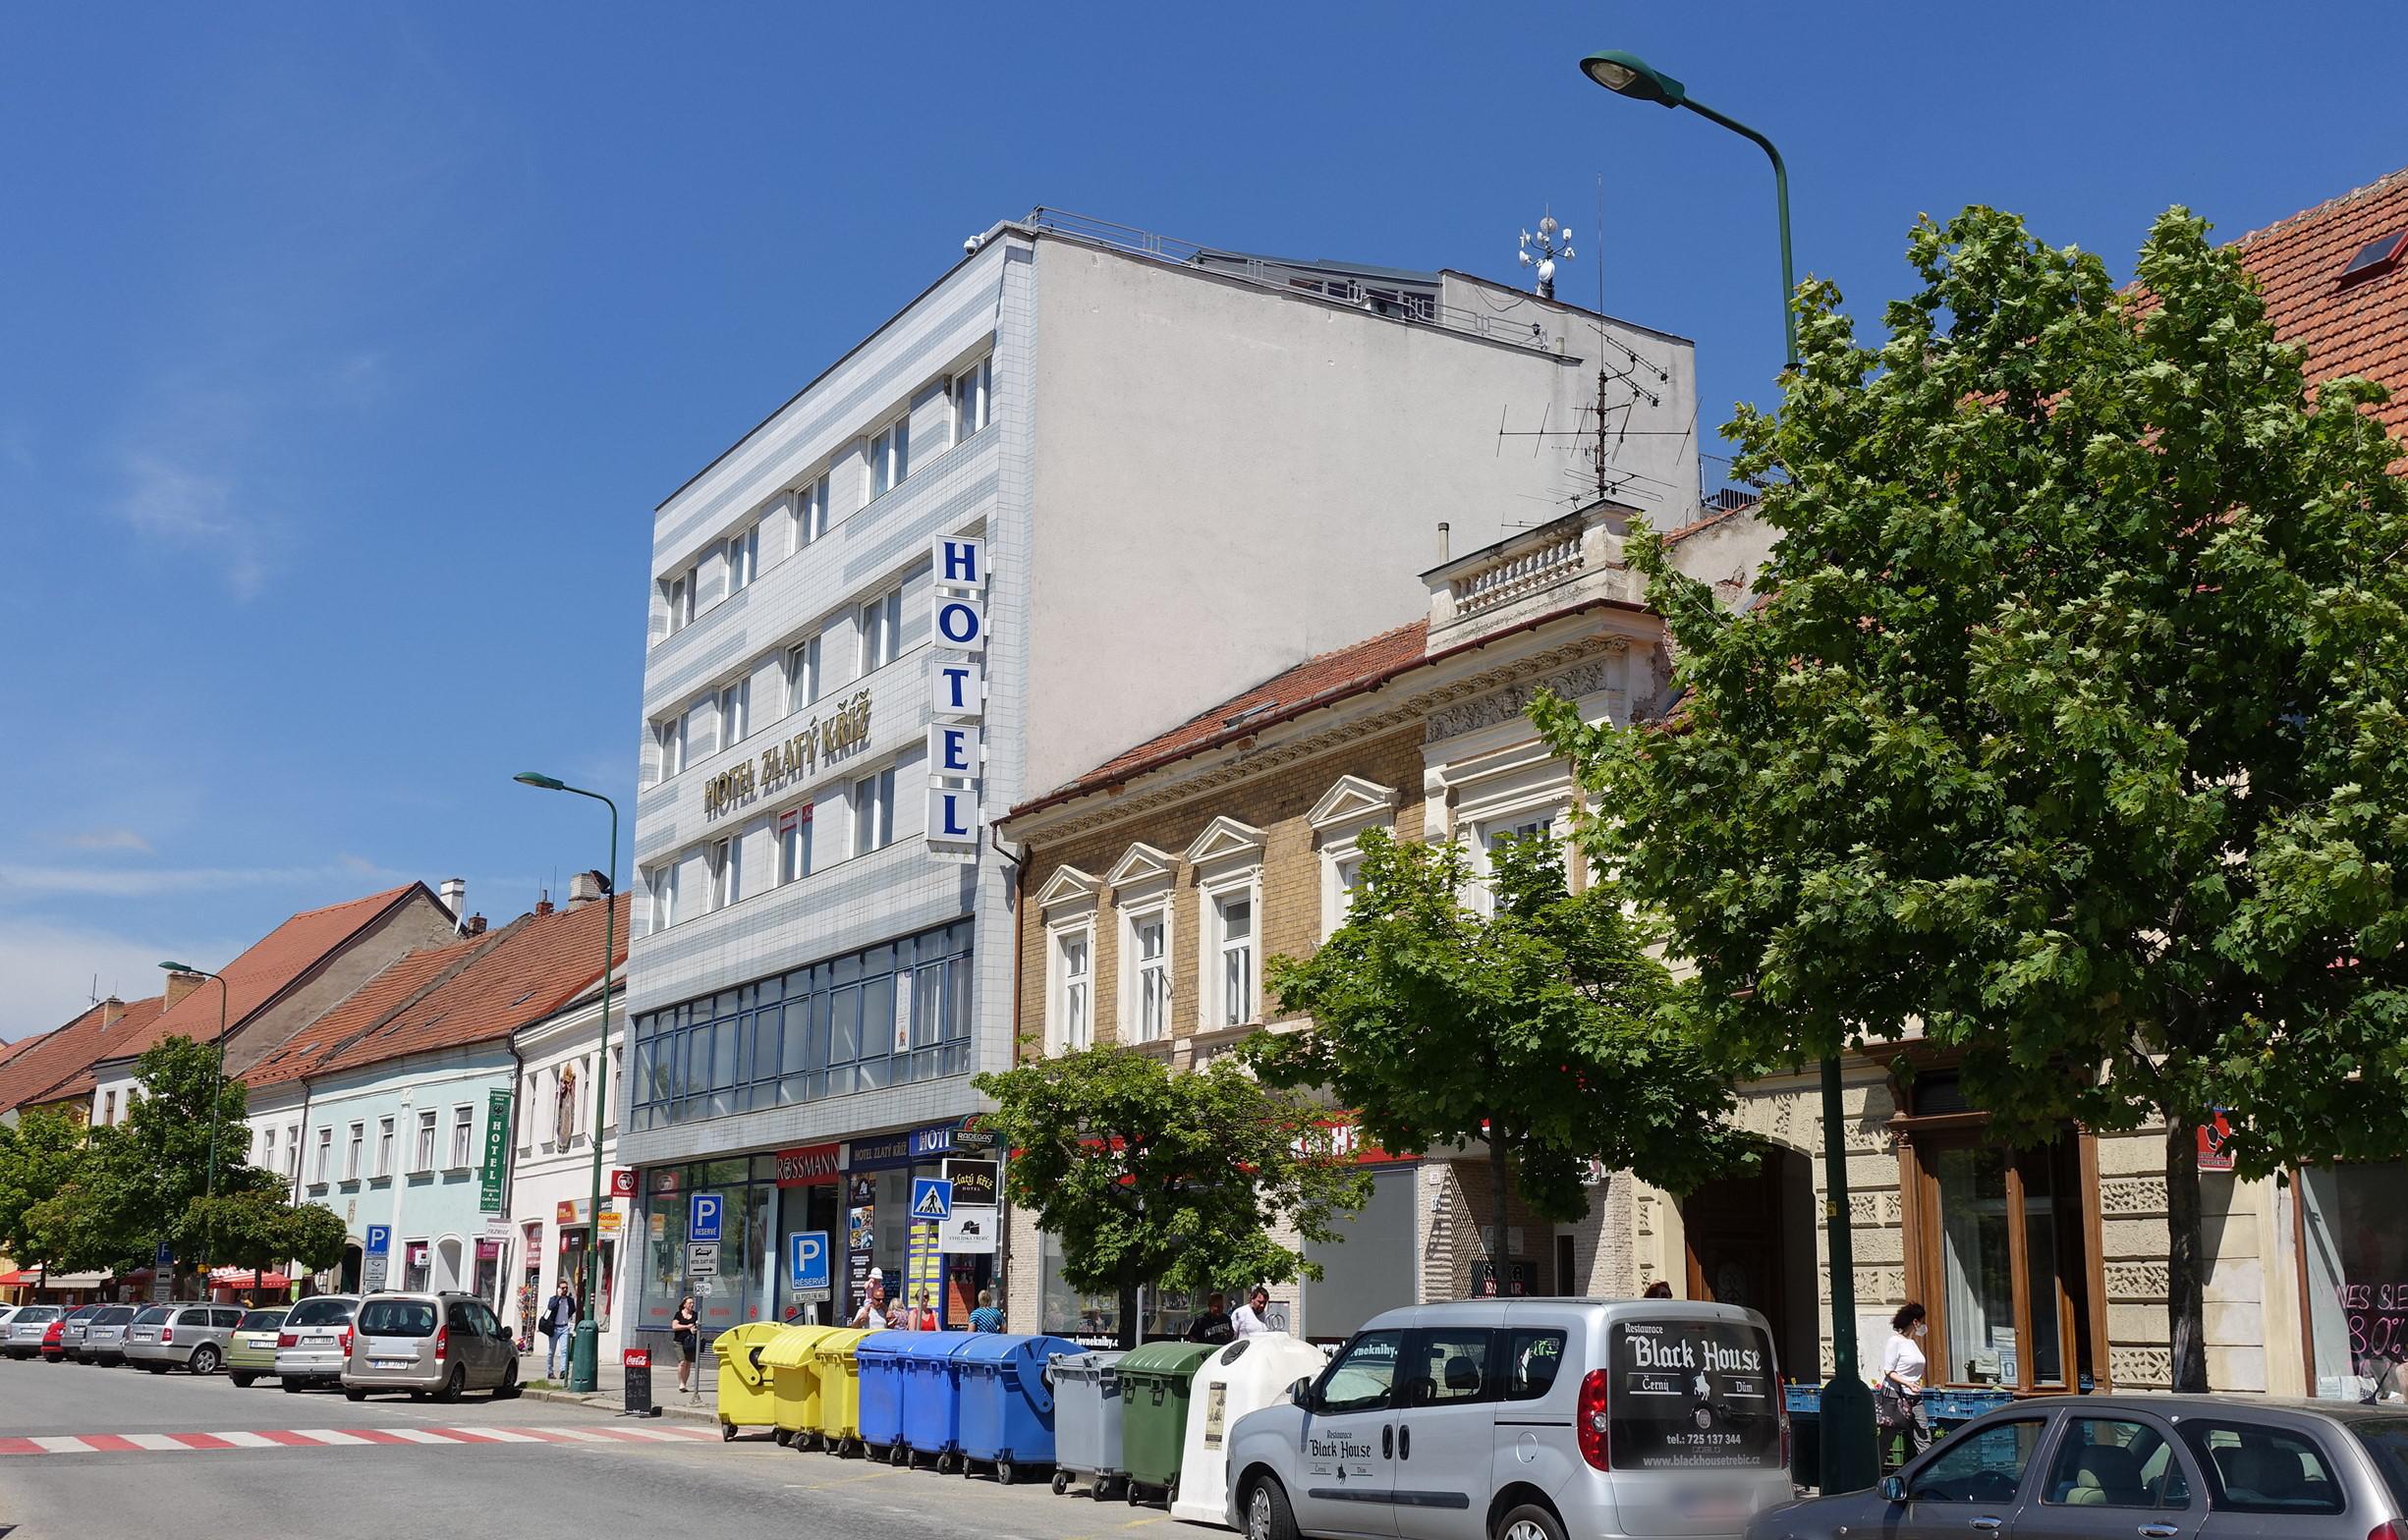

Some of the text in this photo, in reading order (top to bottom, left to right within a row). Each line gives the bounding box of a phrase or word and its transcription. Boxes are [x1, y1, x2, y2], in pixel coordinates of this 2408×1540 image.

[939, 541, 979, 836] HOTEL
[704, 688, 870, 814] HOTEL ZLATÝ KŘÍŽ
[919, 1129, 950, 1152] HOT
[957, 1132, 993, 1144] RADEGAST
[489, 1121, 502, 1181] HOTEL
[777, 1152, 840, 1180] ROSSMANN
[698, 1199, 716, 1227] P
[371, 1230, 386, 1248] P
[799, 1239, 820, 1272] P
[1624, 1322, 1664, 1335] Restaurace
[1625, 1335, 1762, 1372] Black House
[1642, 1374, 1754, 1393] Černý Dům
[1326, 1429, 1353, 1439] Restaurace
[1666, 1433, 1742, 1445] tel.: 725 137 344
[1309, 1439, 1372, 1458] Black House
[1643, 1454, 1761, 1466] www.blackhousetrebic.cz
